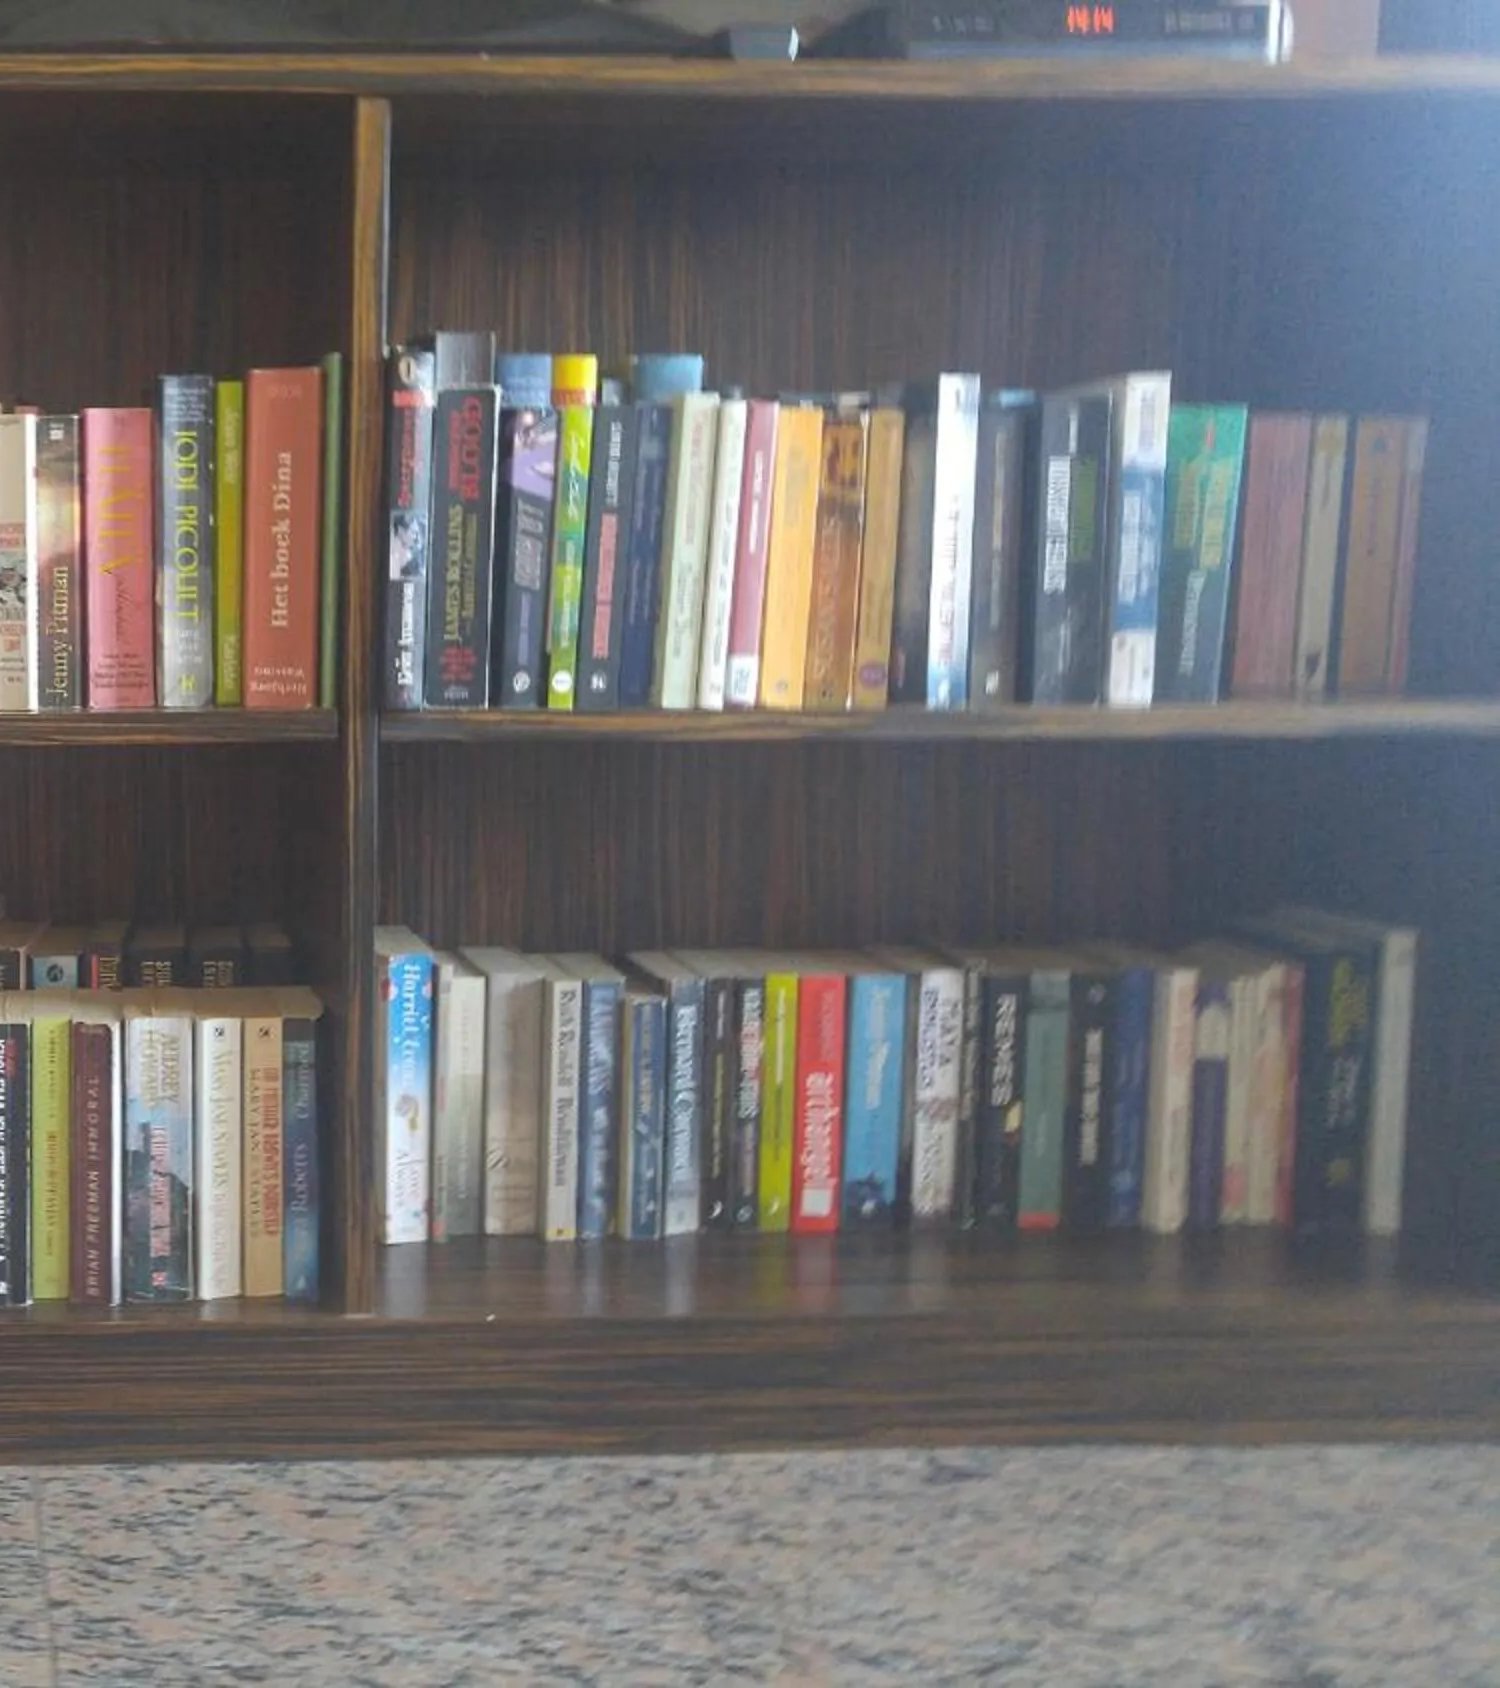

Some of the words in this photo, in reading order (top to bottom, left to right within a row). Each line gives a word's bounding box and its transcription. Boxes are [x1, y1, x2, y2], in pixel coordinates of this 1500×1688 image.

[172, 430, 198, 492] JODI
[461, 397, 483, 501] BLOOD
[273, 451, 292, 512] Dina
[174, 504, 201, 624] PICOULT
[272, 518, 291, 579] boek
[444, 504, 463, 581] ROLLINS
[271, 584, 290, 628] Het
[443, 585, 463, 641] JAMES
[46, 640, 71, 698] Jenny
[160, 1033, 181, 1105] AUDREY
[87, 1074, 100, 1160] IMMORAL
[86, 1170, 100, 1243] FREEMAN
[87, 1249, 100, 1297] BRIAN
